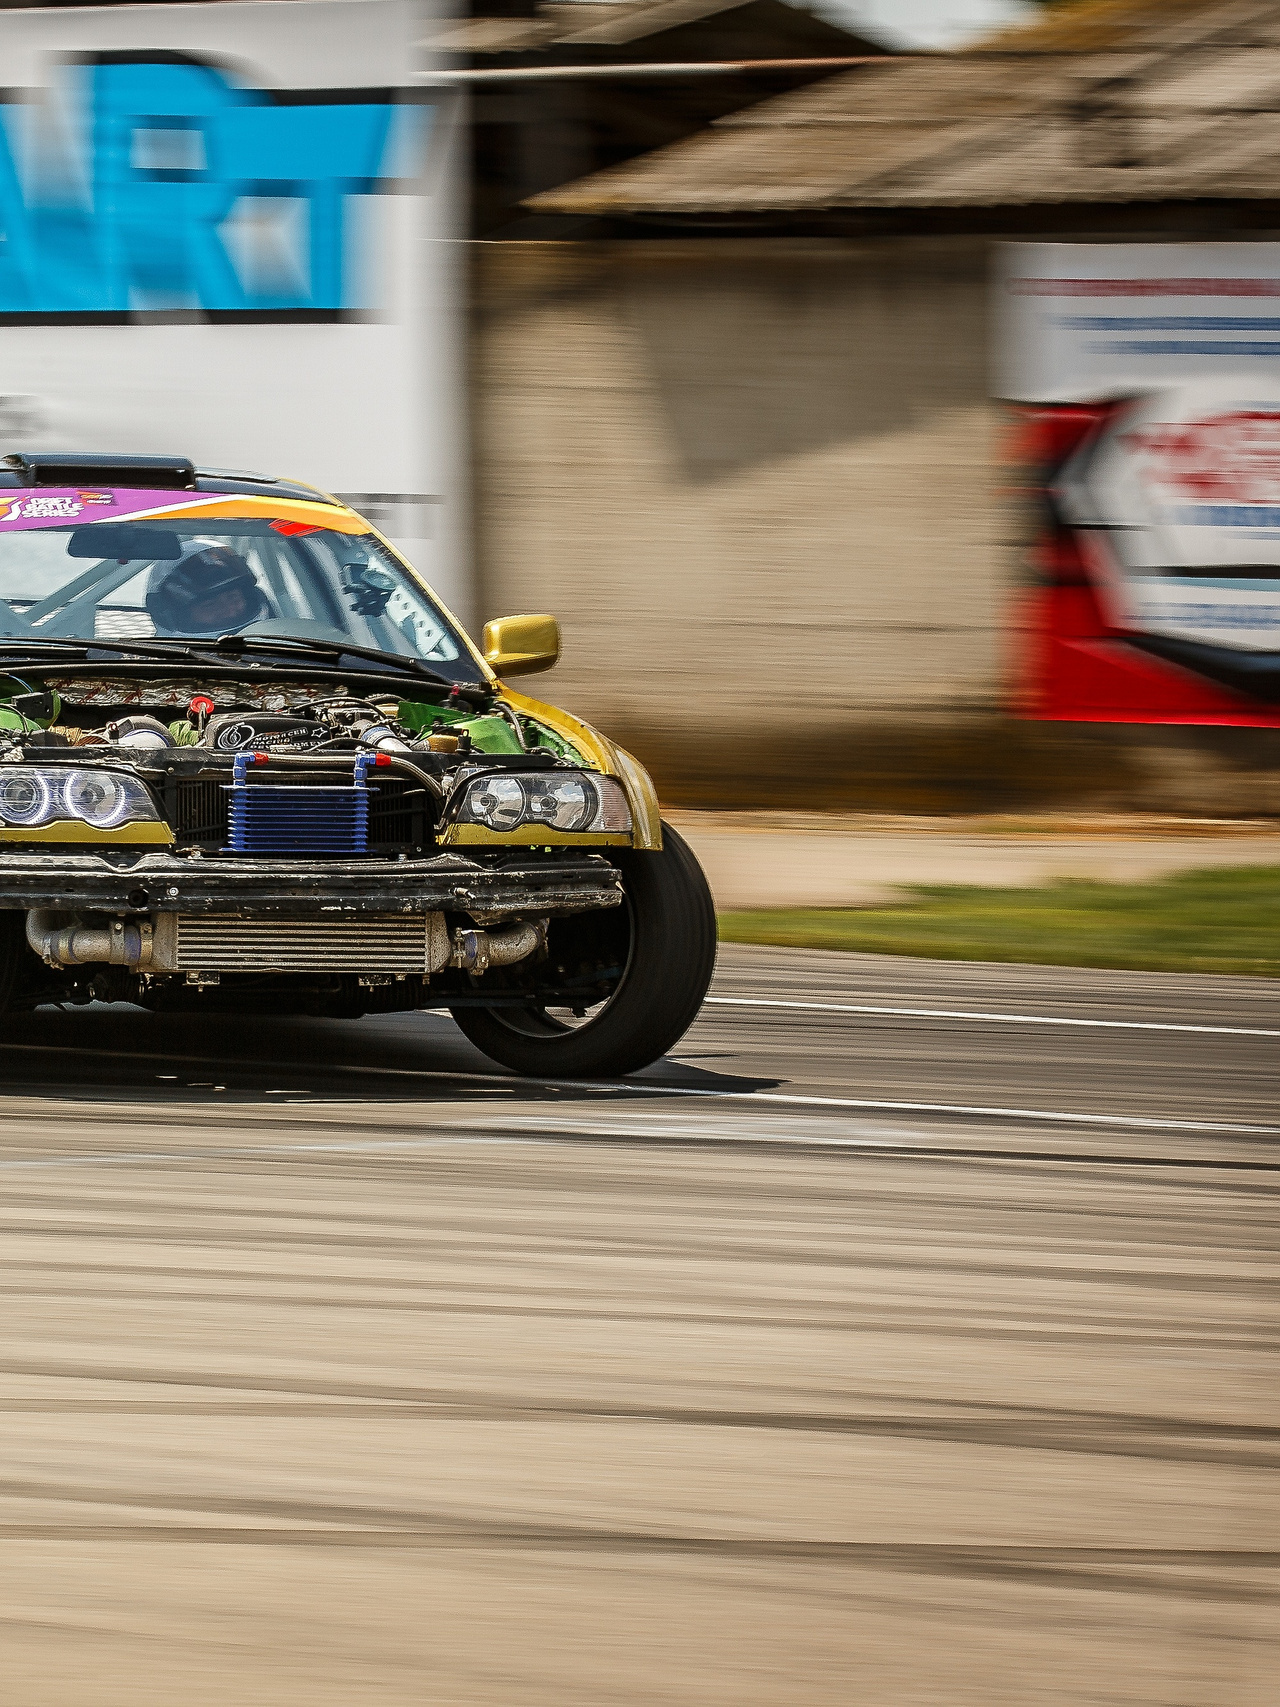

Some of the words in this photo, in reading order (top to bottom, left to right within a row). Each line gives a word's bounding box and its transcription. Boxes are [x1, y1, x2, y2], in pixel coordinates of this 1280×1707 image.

[30, 497, 73, 505] DRIFT
[25, 503, 85, 511] BATTLE
[21, 509, 80, 518] SERIES
